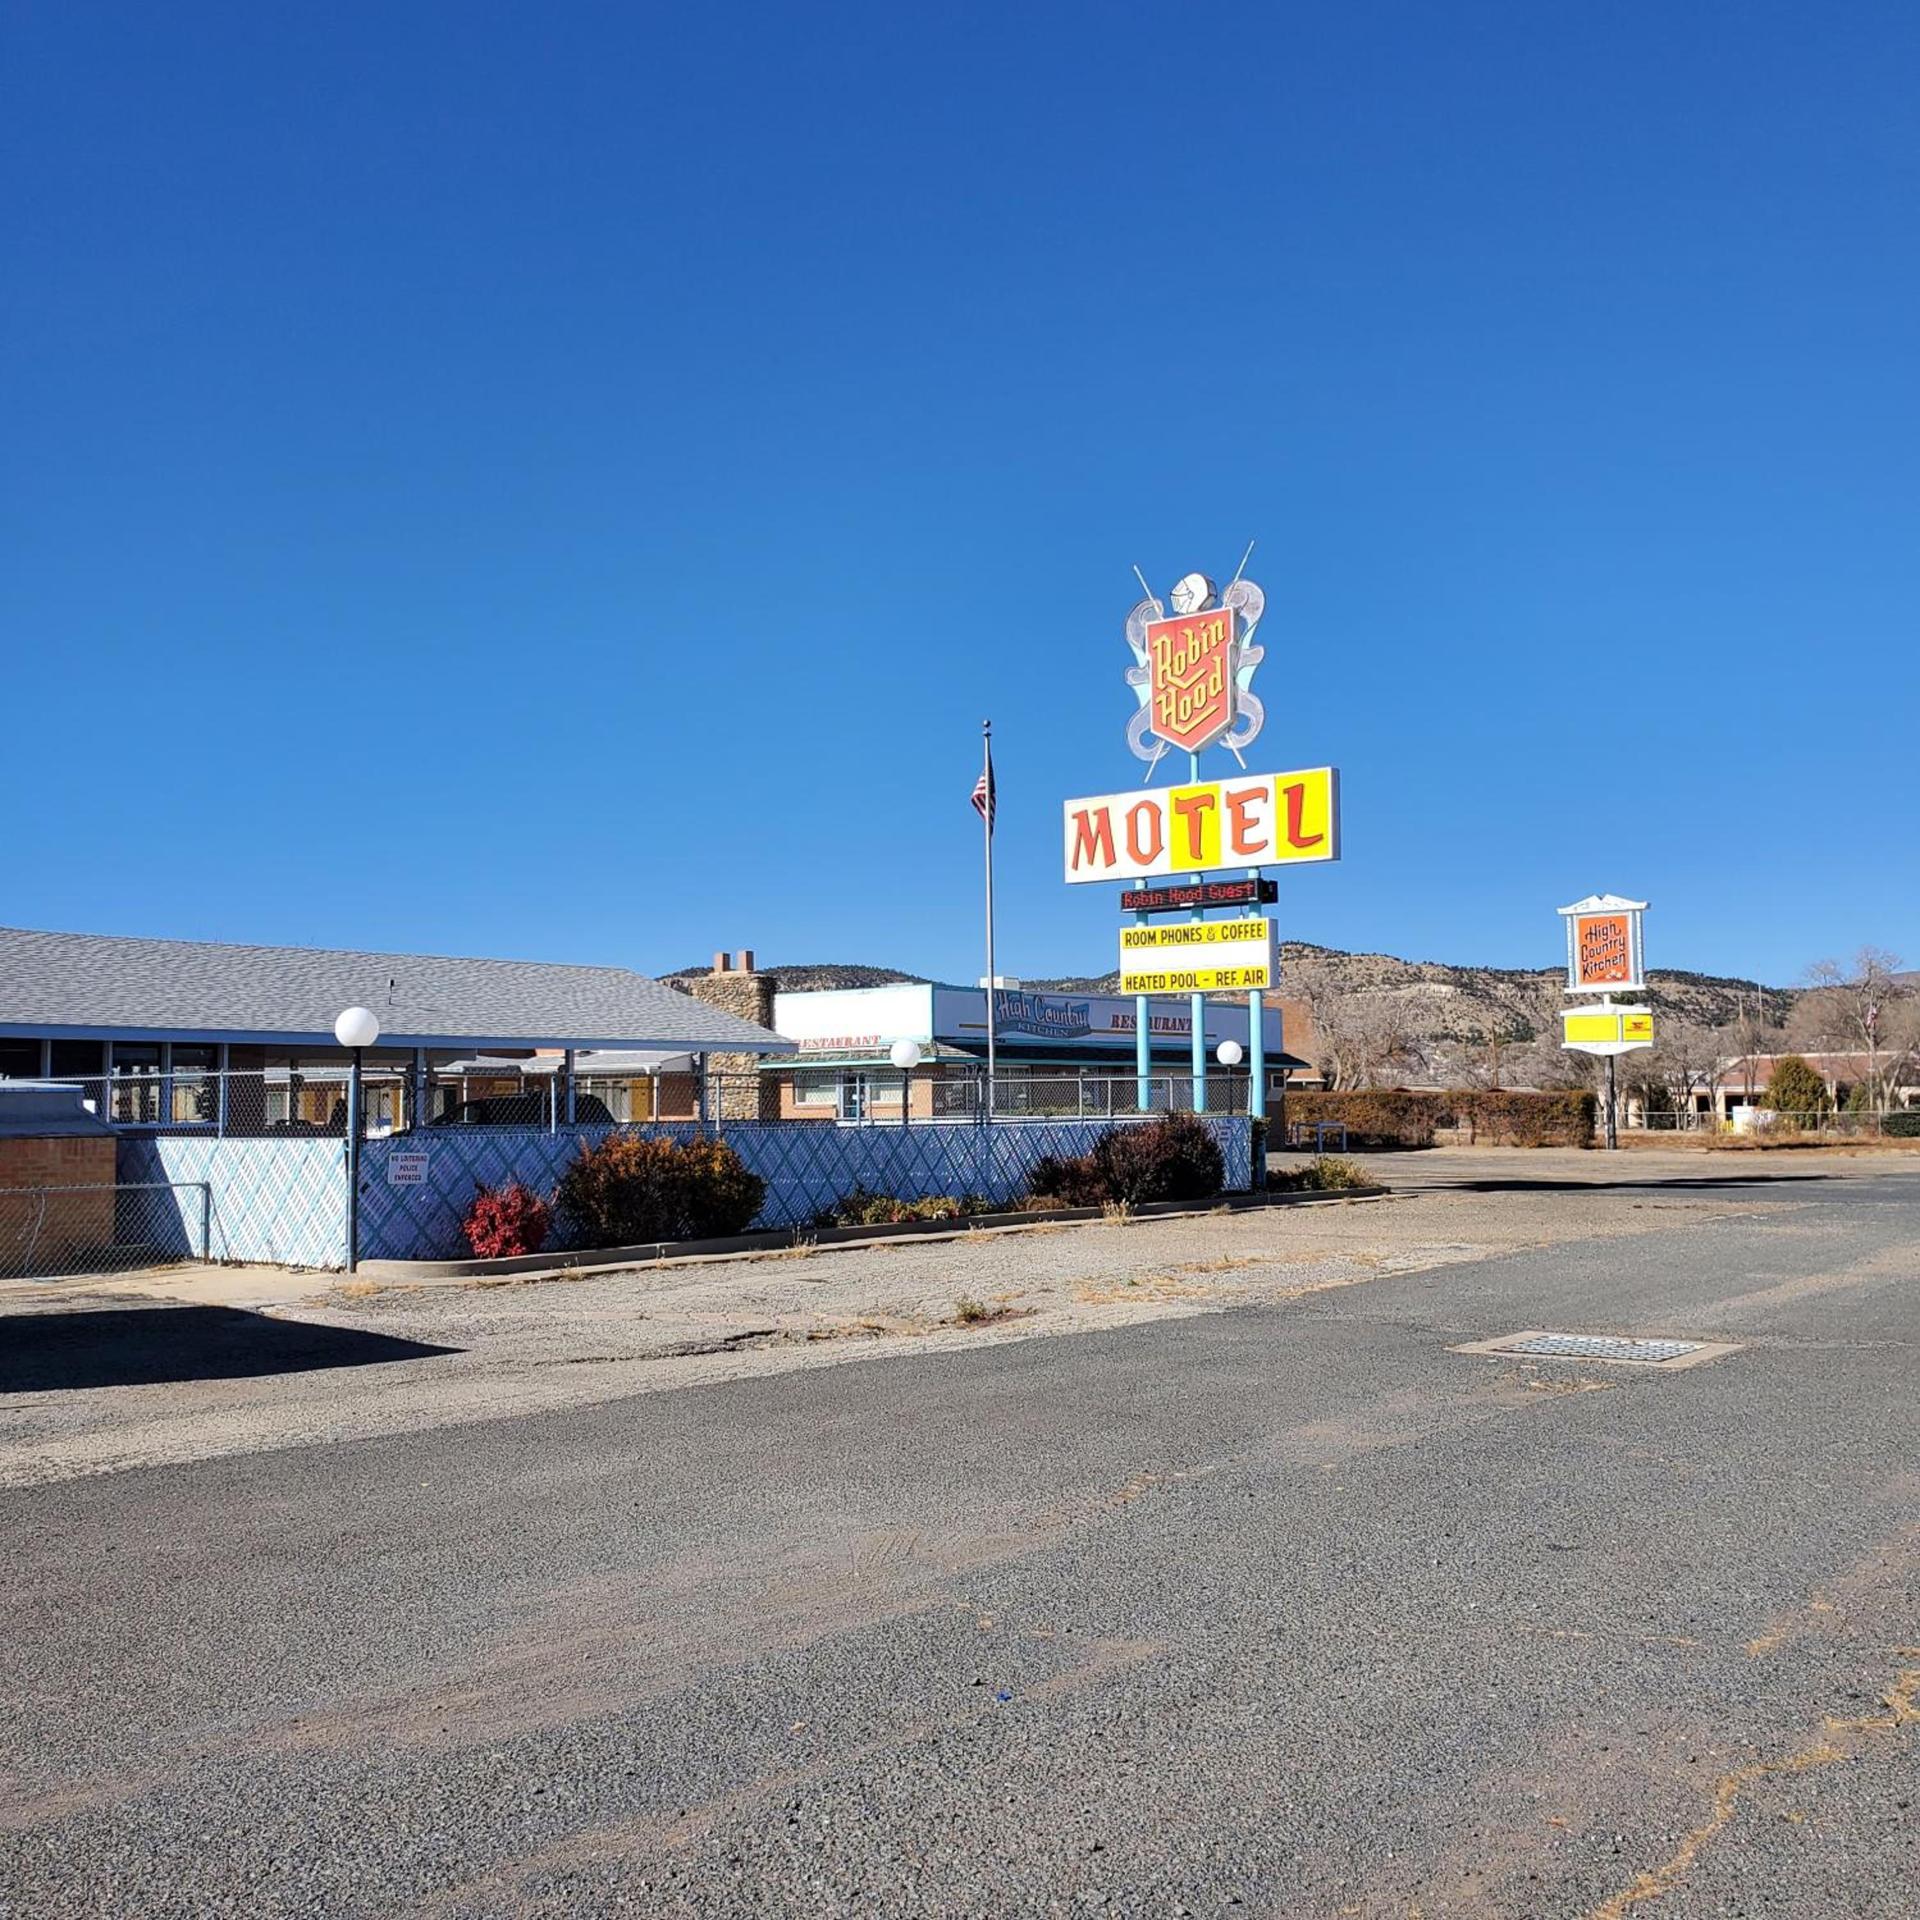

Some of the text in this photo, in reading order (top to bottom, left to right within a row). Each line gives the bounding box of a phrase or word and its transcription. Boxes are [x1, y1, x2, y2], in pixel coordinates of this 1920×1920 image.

[1152, 617, 1226, 692] Robin
[1156, 655, 1225, 736] Hood
[1071, 783, 1324, 871] MOTEL
[1124, 883, 1254, 907] Robin Hood Guest
[1125, 923, 1263, 946] ROOM PHONES & COFFEE
[1585, 920, 1622, 942] High
[1580, 935, 1626, 962] Country
[1582, 952, 1626, 980] Kitchen
[1125, 975, 1166, 991] HEATED
[1170, 973, 1200, 988] POOL
[1216, 971, 1239, 986] REF.
[1243, 969, 1264, 984] AIR
[998, 991, 1088, 1027] High Country
[1017, 1022, 1069, 1036] KITCHEN
[1111, 1014, 1192, 1031] RESAURANT
